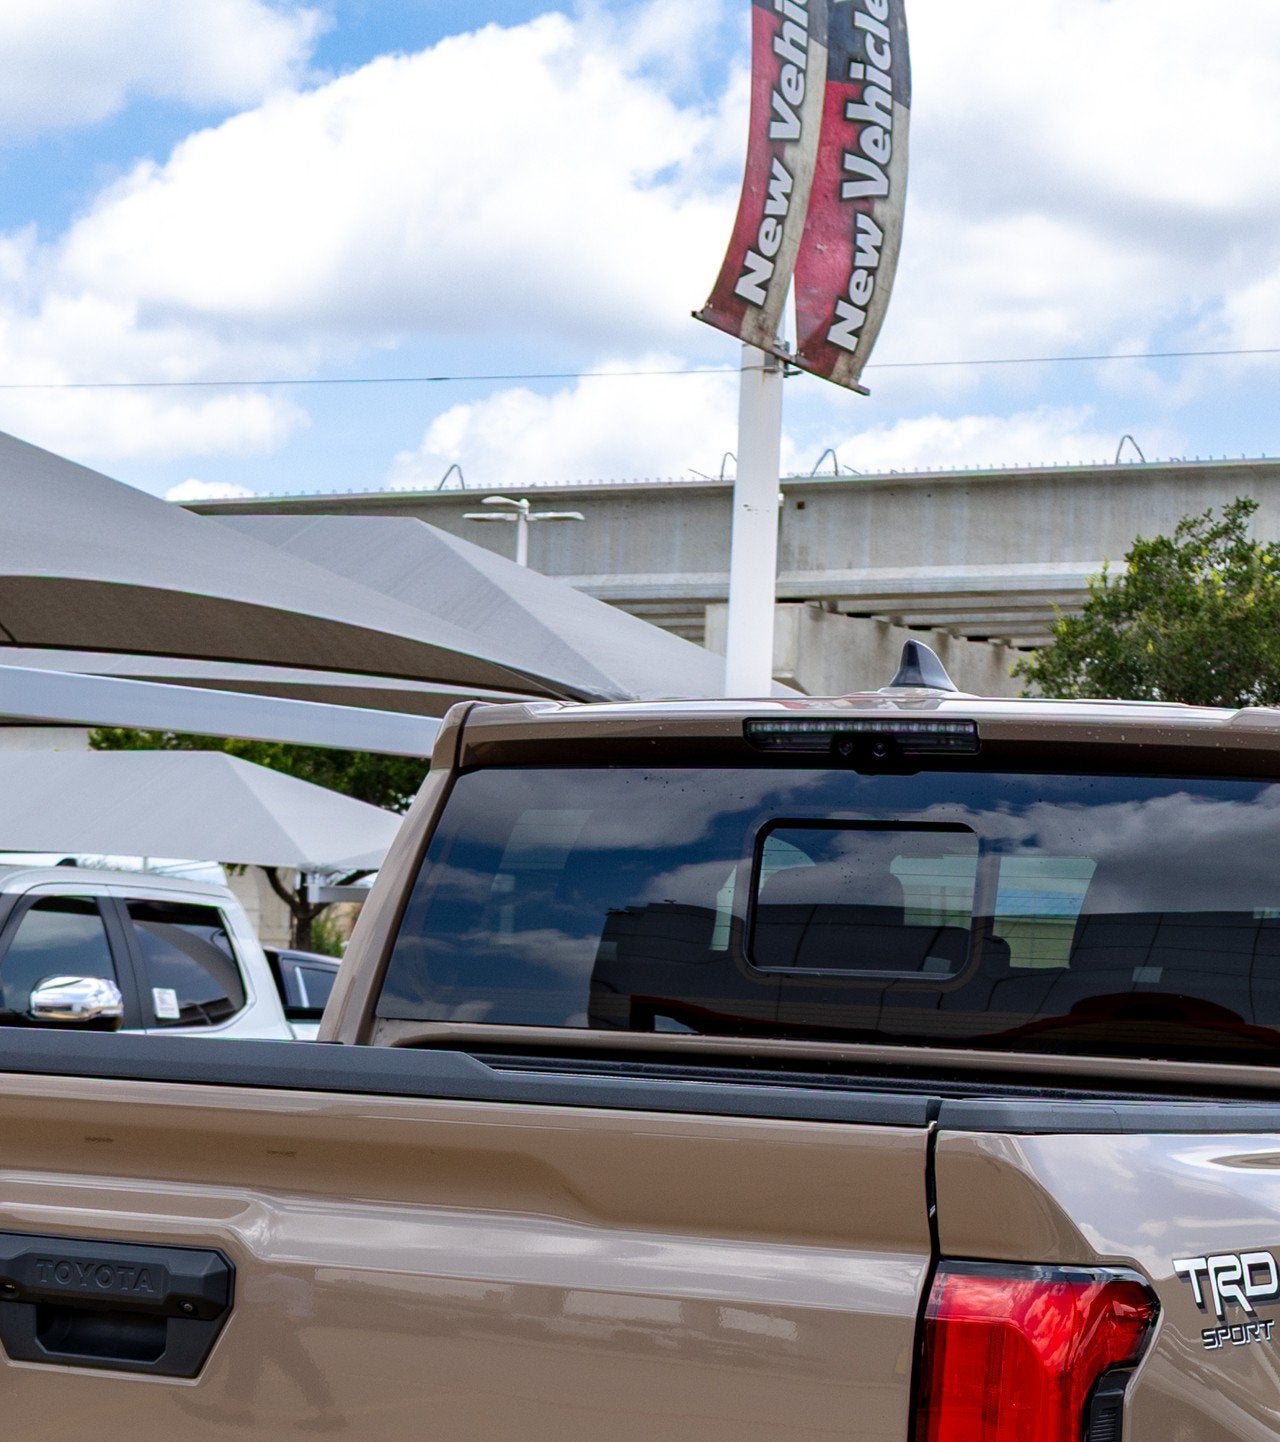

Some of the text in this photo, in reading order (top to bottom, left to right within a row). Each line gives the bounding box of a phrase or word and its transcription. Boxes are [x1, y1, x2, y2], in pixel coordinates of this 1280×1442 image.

[733, 0, 810, 307] New Vehi
[826, 212, 884, 352] New
[36, 1258, 155, 1293] TOYOTA
[1201, 1319, 1275, 1350] SPORT
